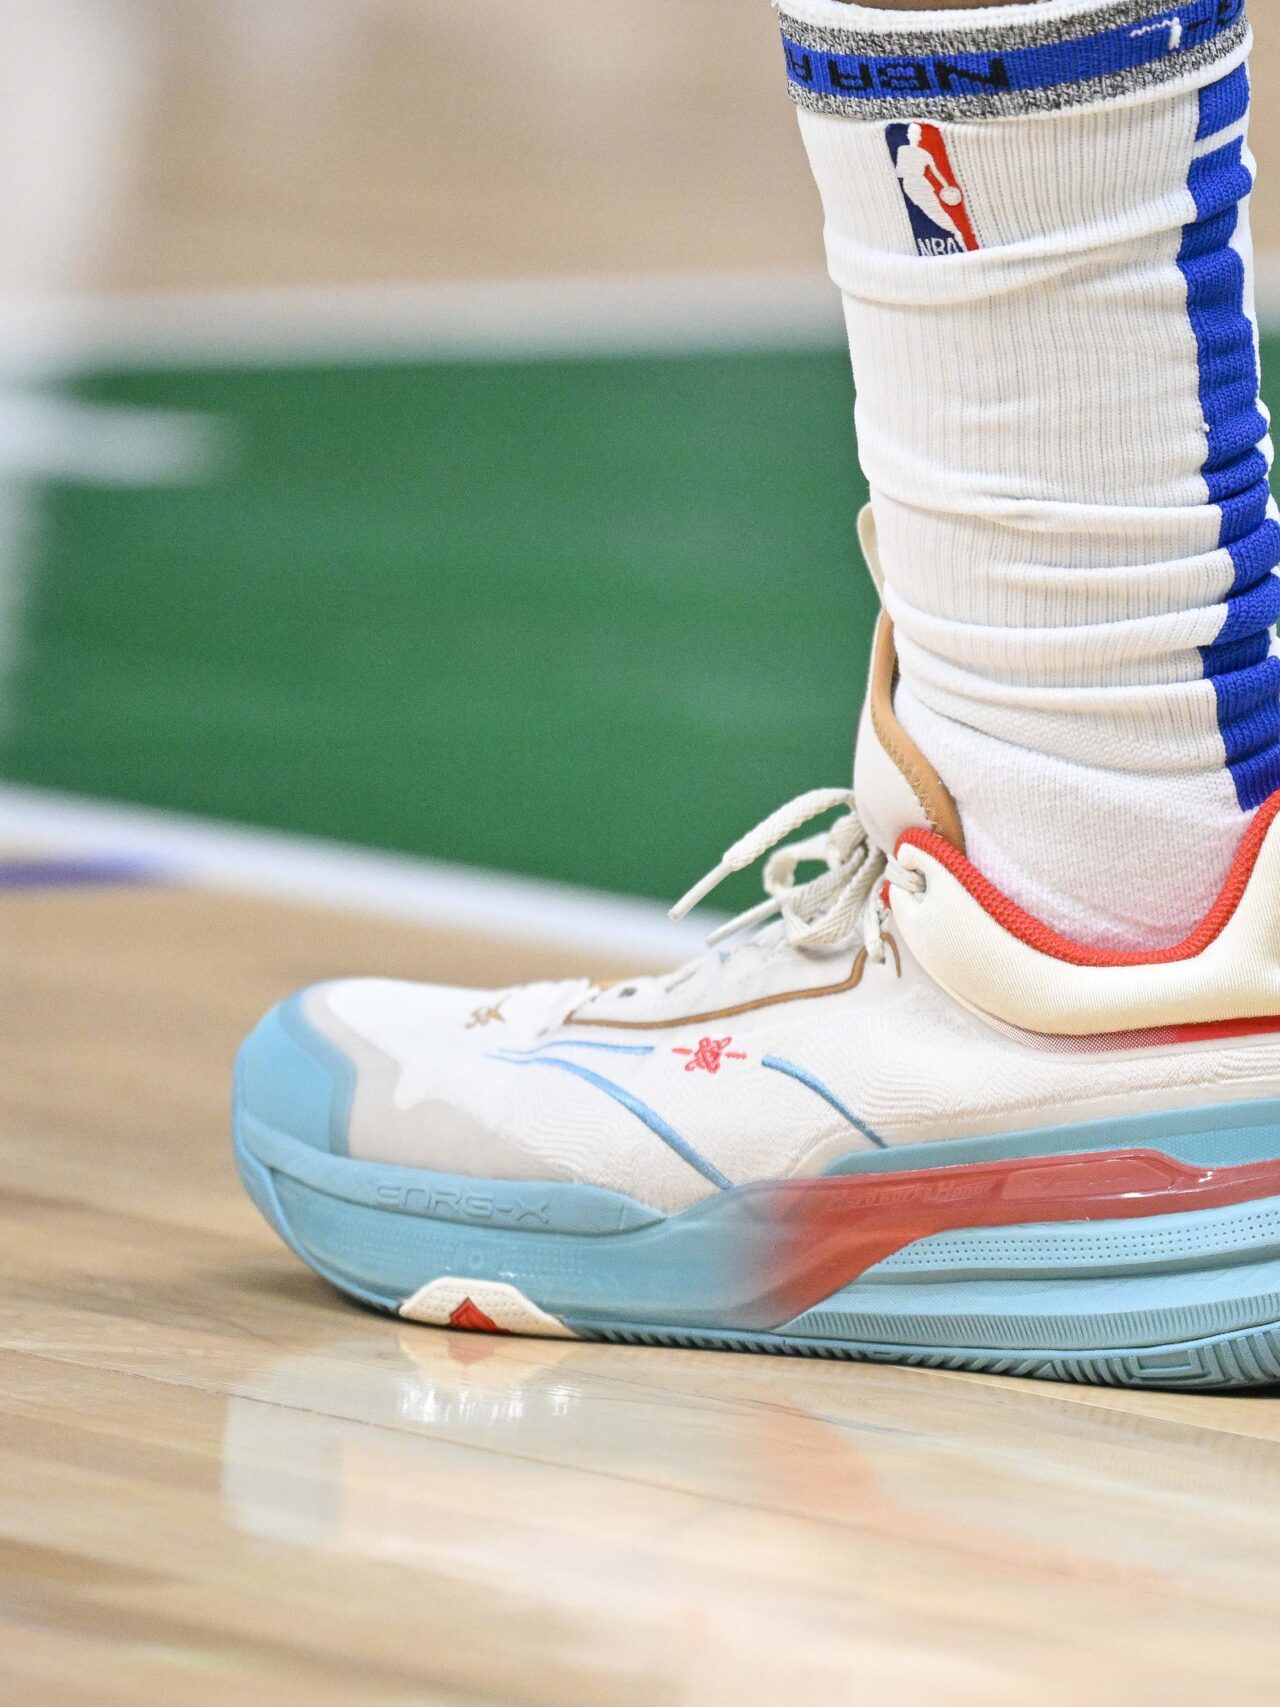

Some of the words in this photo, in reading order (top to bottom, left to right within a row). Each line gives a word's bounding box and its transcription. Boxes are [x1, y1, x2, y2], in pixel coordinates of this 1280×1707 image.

[828, 58, 1009, 91] NBA
[918, 237, 960, 256] NBA
[375, 1185, 552, 1226] ENRG-X
